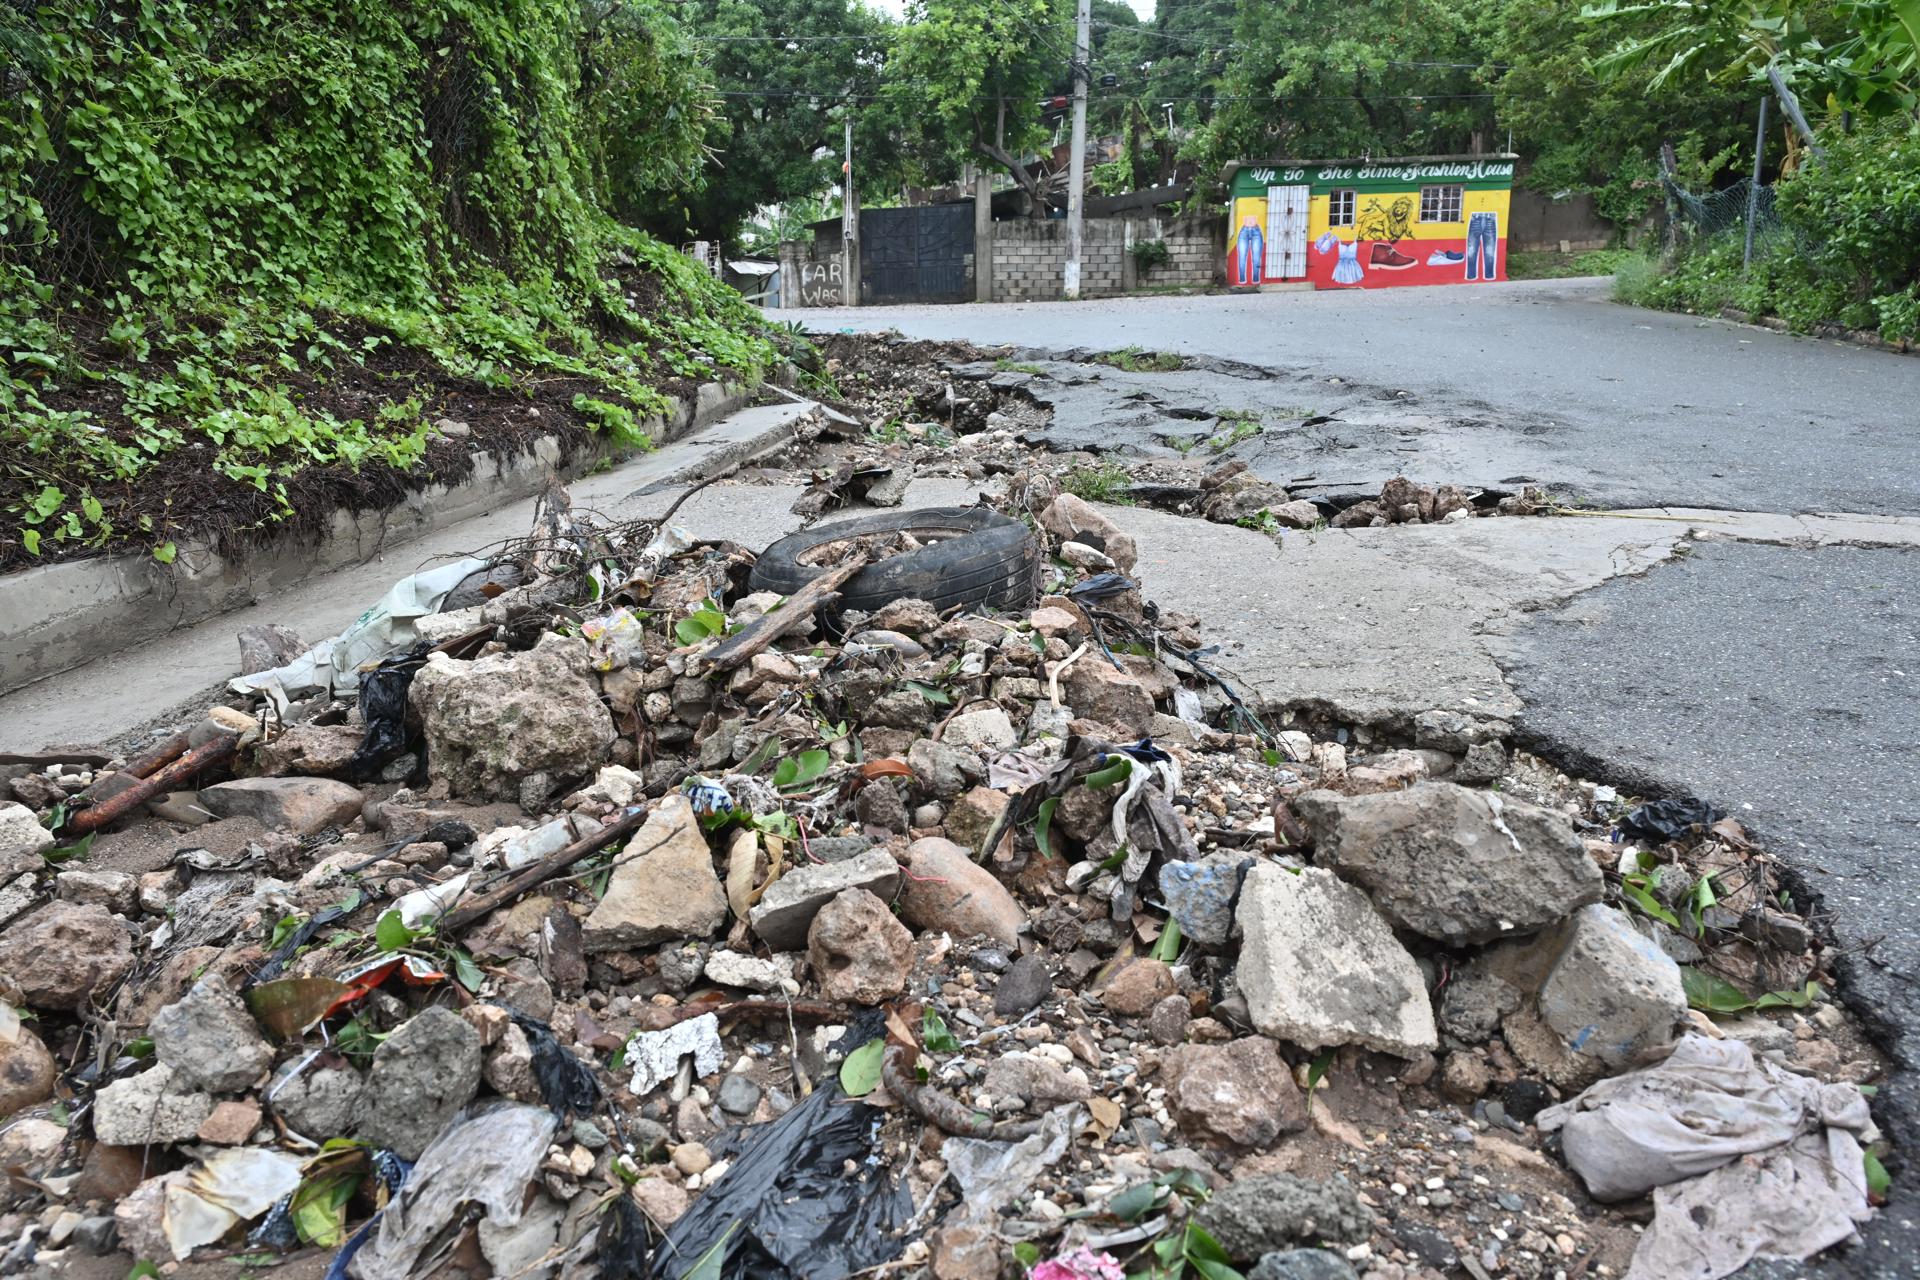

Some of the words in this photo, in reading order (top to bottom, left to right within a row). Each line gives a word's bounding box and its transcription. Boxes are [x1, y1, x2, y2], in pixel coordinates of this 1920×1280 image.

[1250, 167, 1277, 185] Up
[1283, 166, 1306, 181] To
[1318, 164, 1354, 180] The
[1357, 163, 1402, 179] Time
[802, 263, 843, 287] CAR
